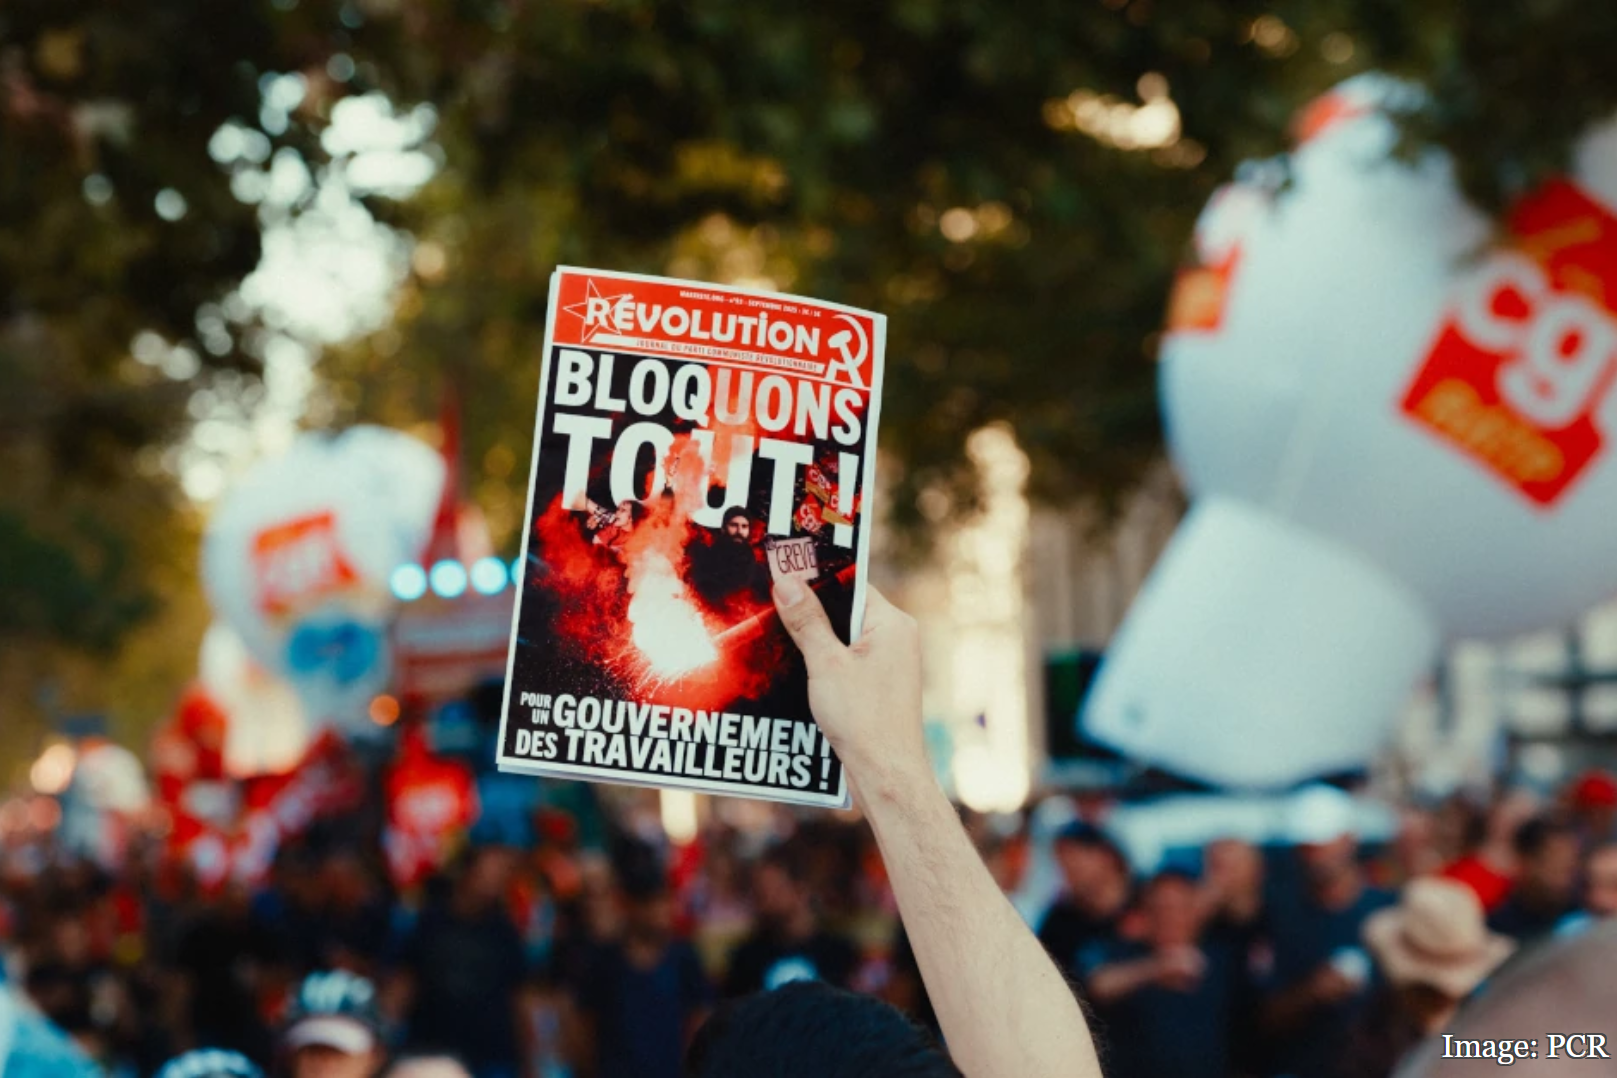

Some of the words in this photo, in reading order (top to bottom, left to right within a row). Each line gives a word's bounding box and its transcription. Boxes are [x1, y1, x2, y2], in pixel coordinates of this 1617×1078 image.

[636, 338, 669, 351] JOURNAL
[671, 343, 680, 352] DU
[683, 344, 706, 355] PARTI
[707, 347, 753, 362] COMMUNISTE
[1453, 248, 1617, 437] cg
[554, 349, 862, 445] BLOQUONS
[553, 413, 813, 537] TOUT
[832, 451, 859, 548] !
[520, 691, 552, 709] POUR
[531, 708, 550, 725] UN
[514, 728, 558, 759] DES
[564, 727, 812, 789] TRAVAILLEURS
[819, 757, 831, 790] !
